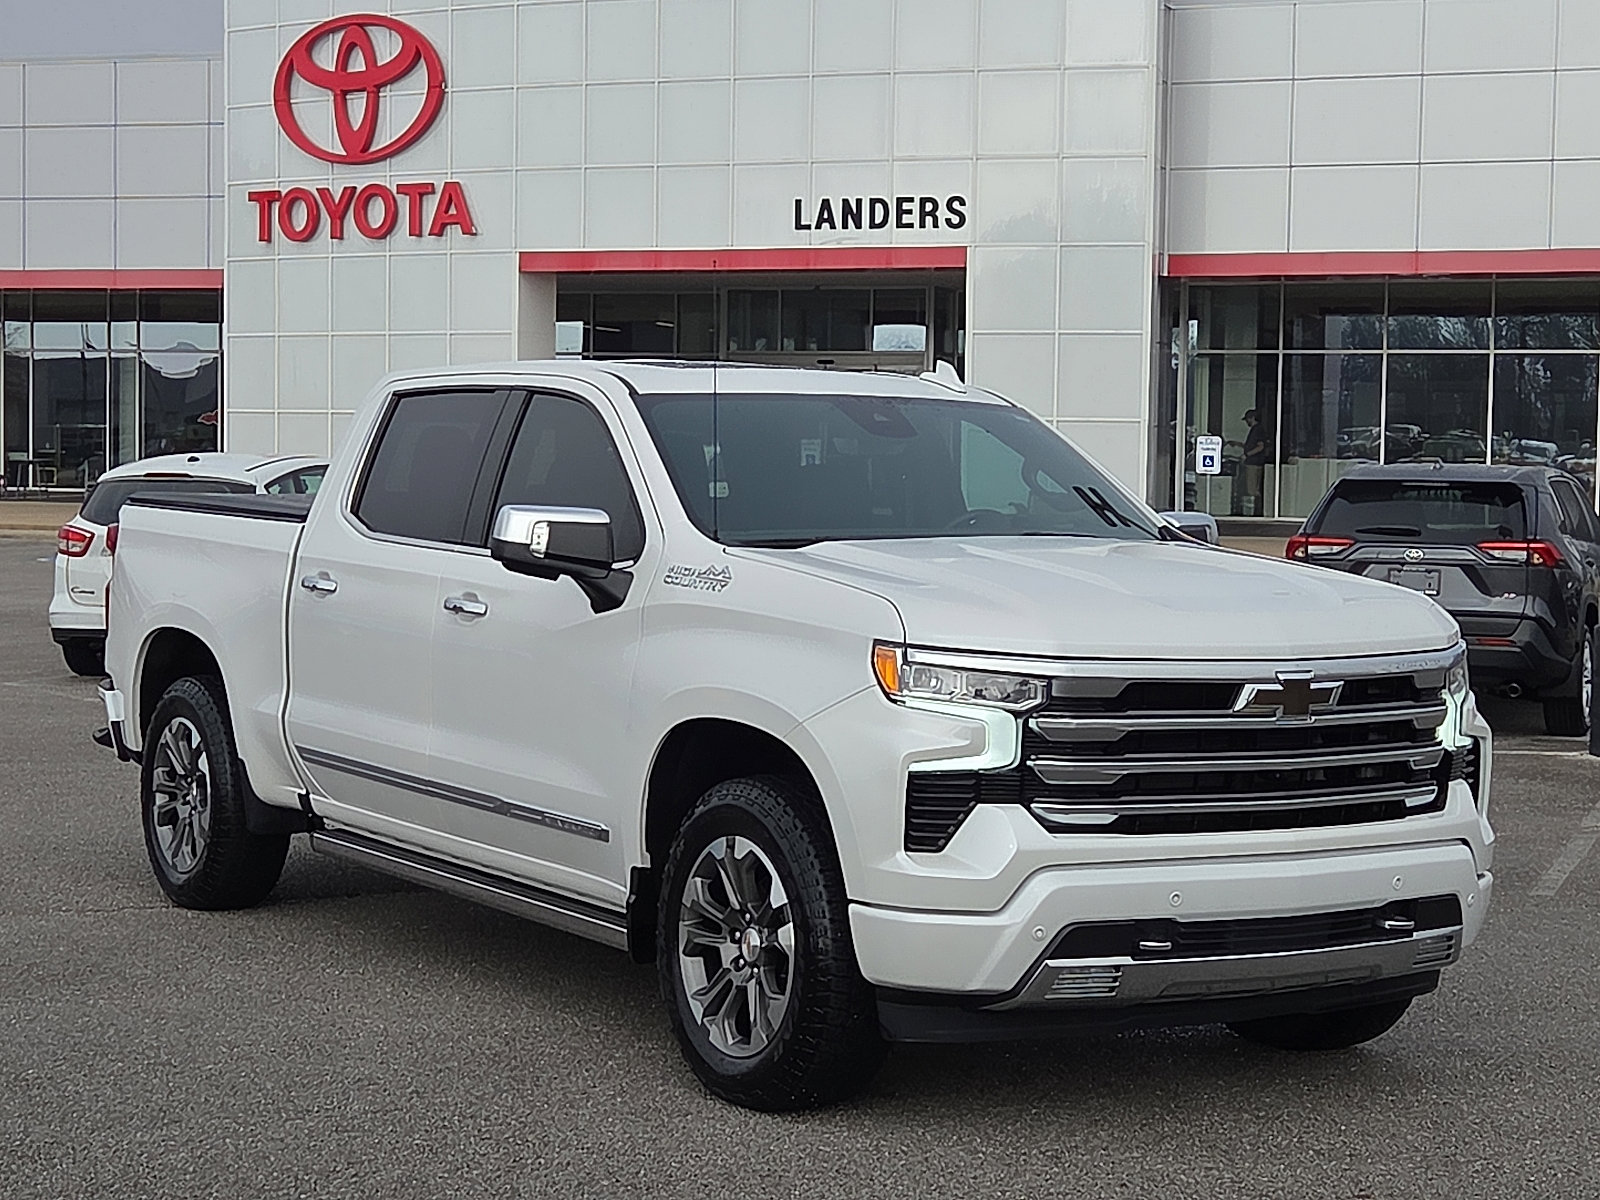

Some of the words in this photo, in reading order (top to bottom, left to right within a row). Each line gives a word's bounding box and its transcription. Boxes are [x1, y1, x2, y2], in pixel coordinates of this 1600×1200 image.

[248, 181, 477, 242] TOYOTA
[794, 196, 967, 230] LANDERS
[664, 575, 729, 592] COUNTRY
